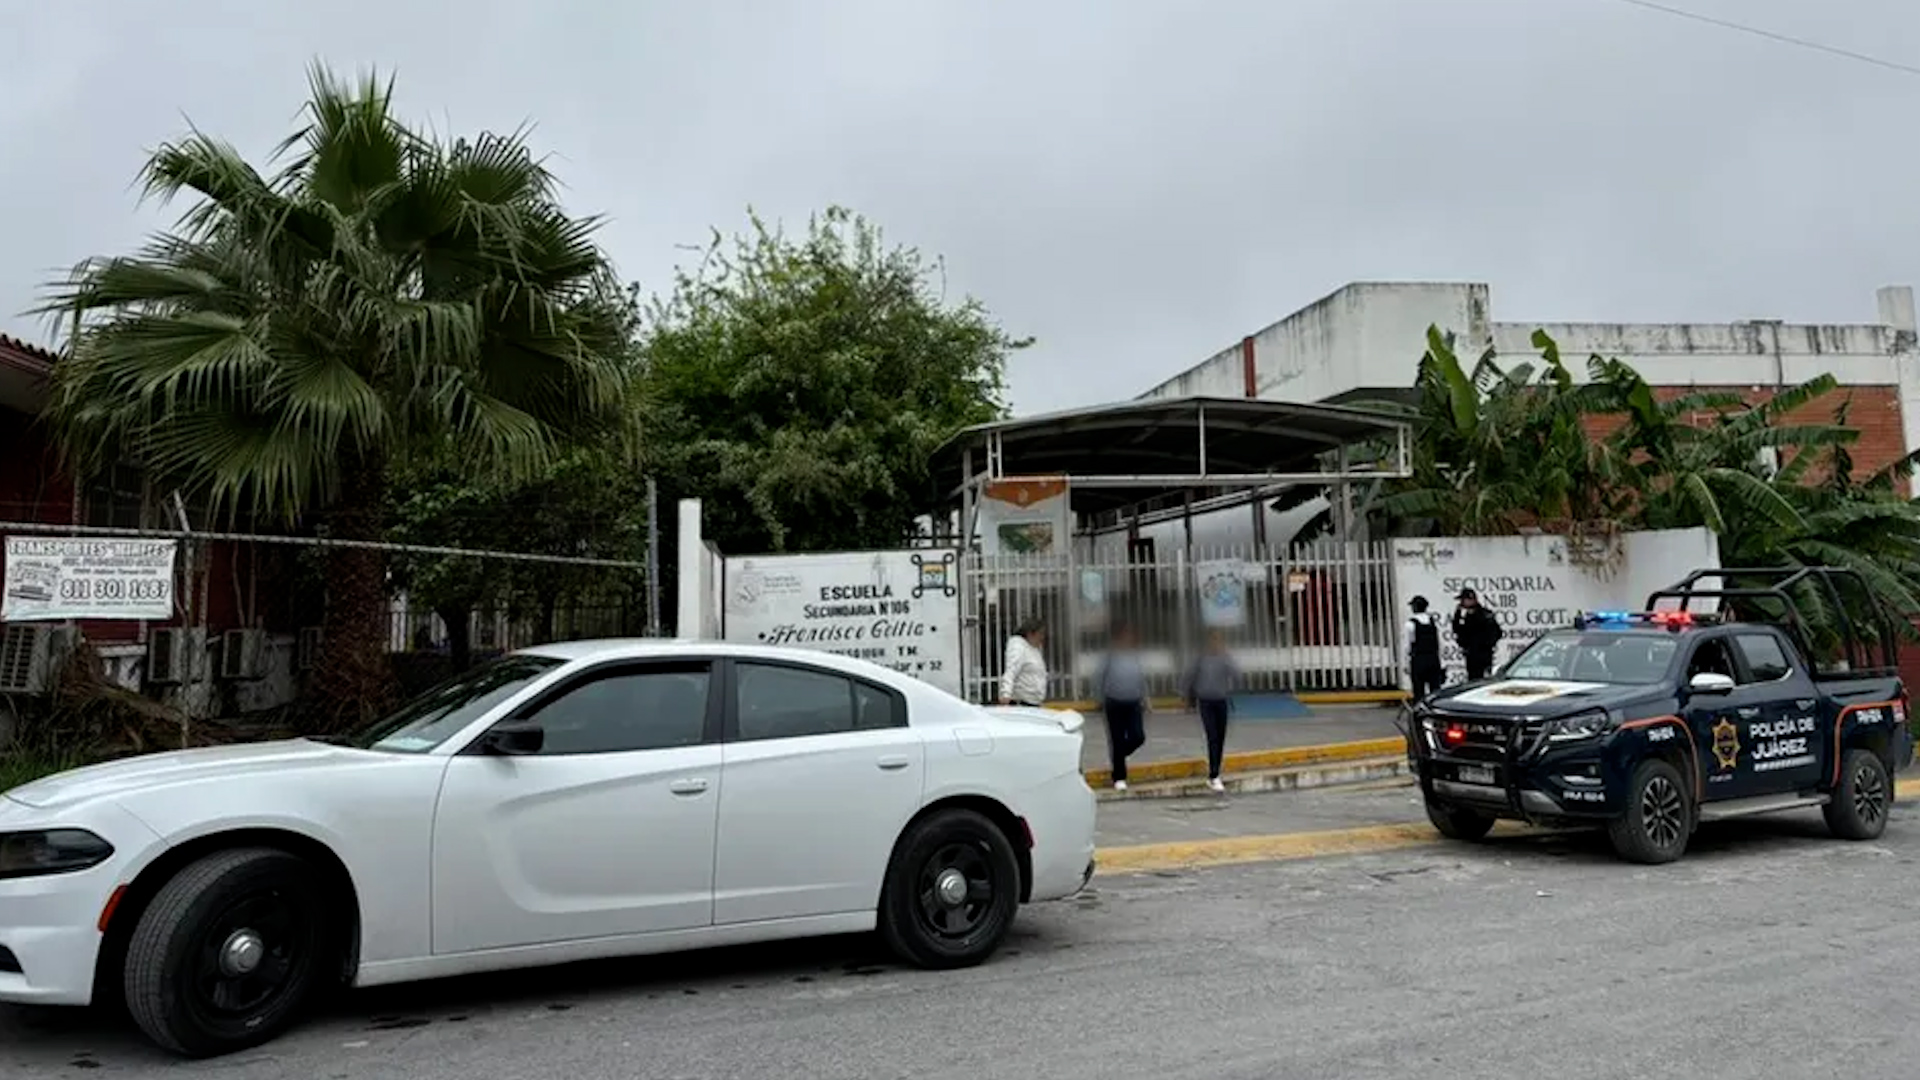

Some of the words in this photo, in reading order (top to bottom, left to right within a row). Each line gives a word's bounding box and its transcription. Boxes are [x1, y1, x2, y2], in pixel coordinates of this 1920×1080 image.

[61, 579, 91, 599] 811
[94, 579, 125, 599] 301
[129, 579, 169, 599] 1687
[820, 585, 893, 600] ESCUELA
[1442, 576, 1555, 593] SECUNDARIA
[1749, 714, 1798, 739] POLICÍA
[1797, 717, 1815, 733] DE
[1751, 735, 1808, 760] JUÁREZ
